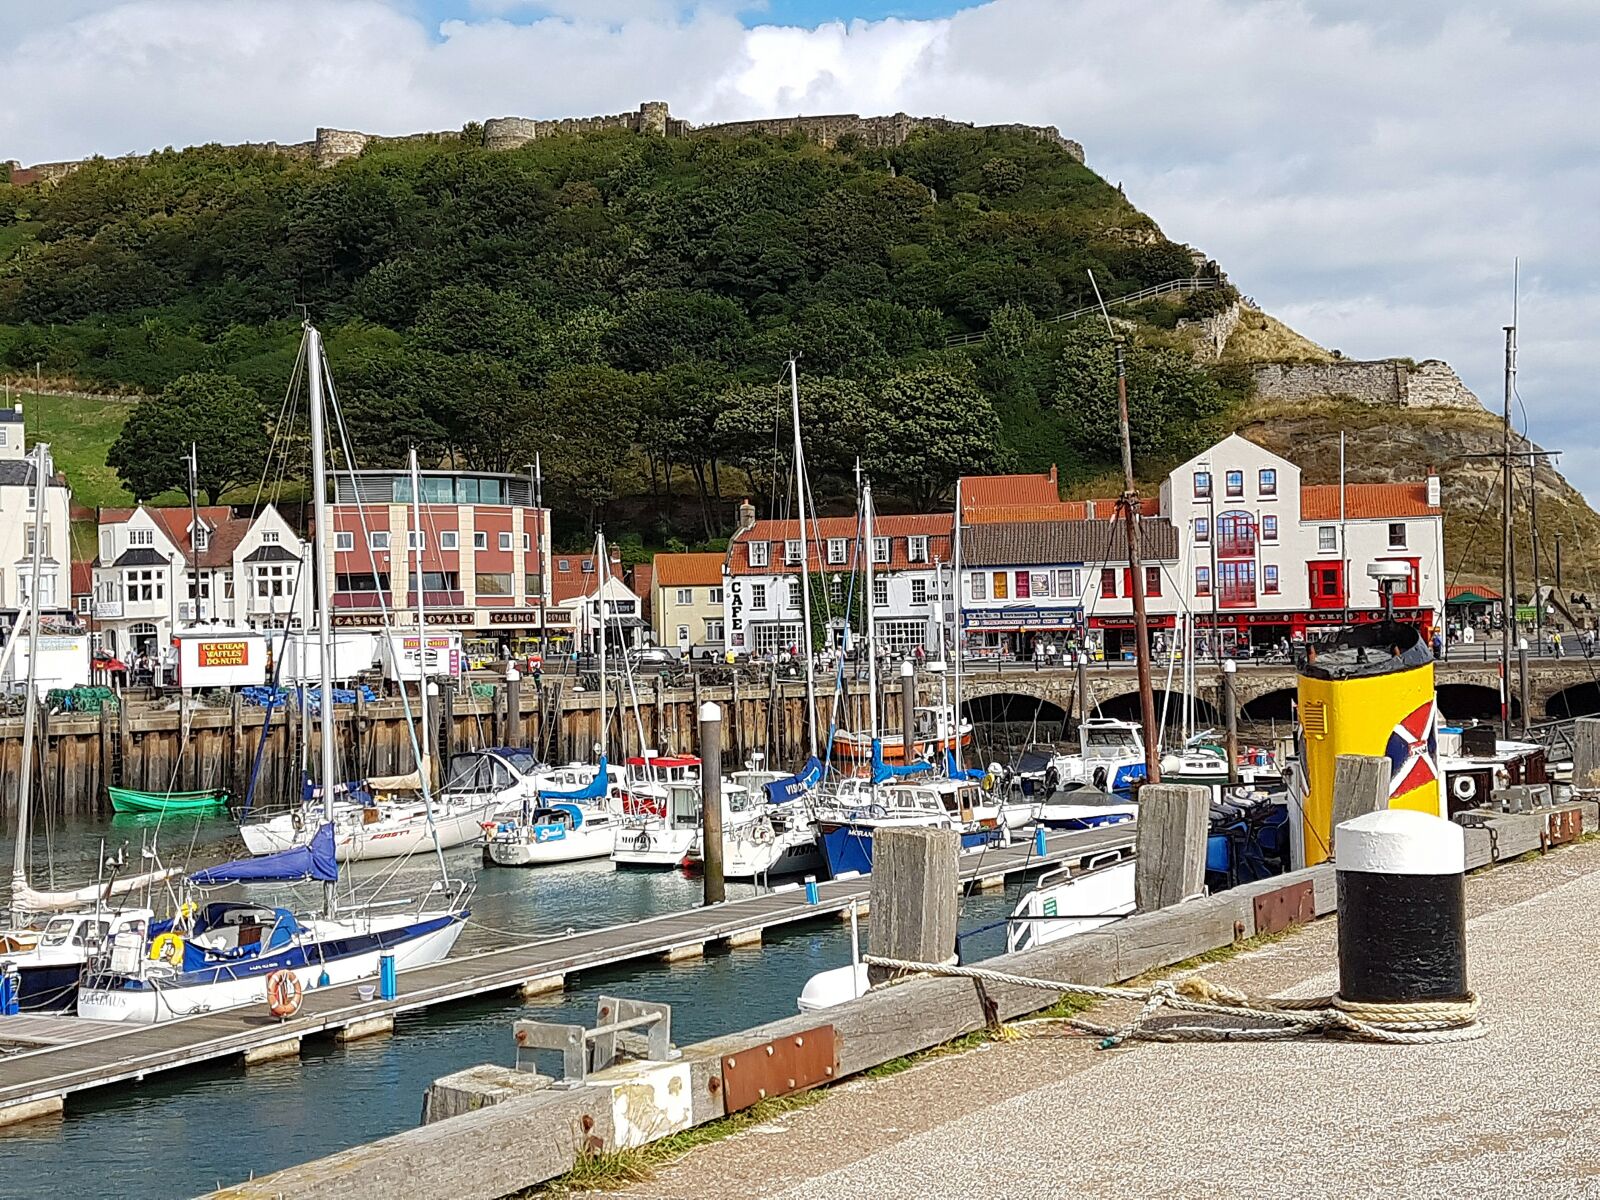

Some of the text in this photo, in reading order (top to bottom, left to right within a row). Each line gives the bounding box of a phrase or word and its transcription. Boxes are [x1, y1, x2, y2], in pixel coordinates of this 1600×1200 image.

[731, 582, 743, 630] CAFE
[335, 616, 390, 626] CASINO
[425, 614, 470, 624] OYALE
[494, 614, 532, 623] CASINO
